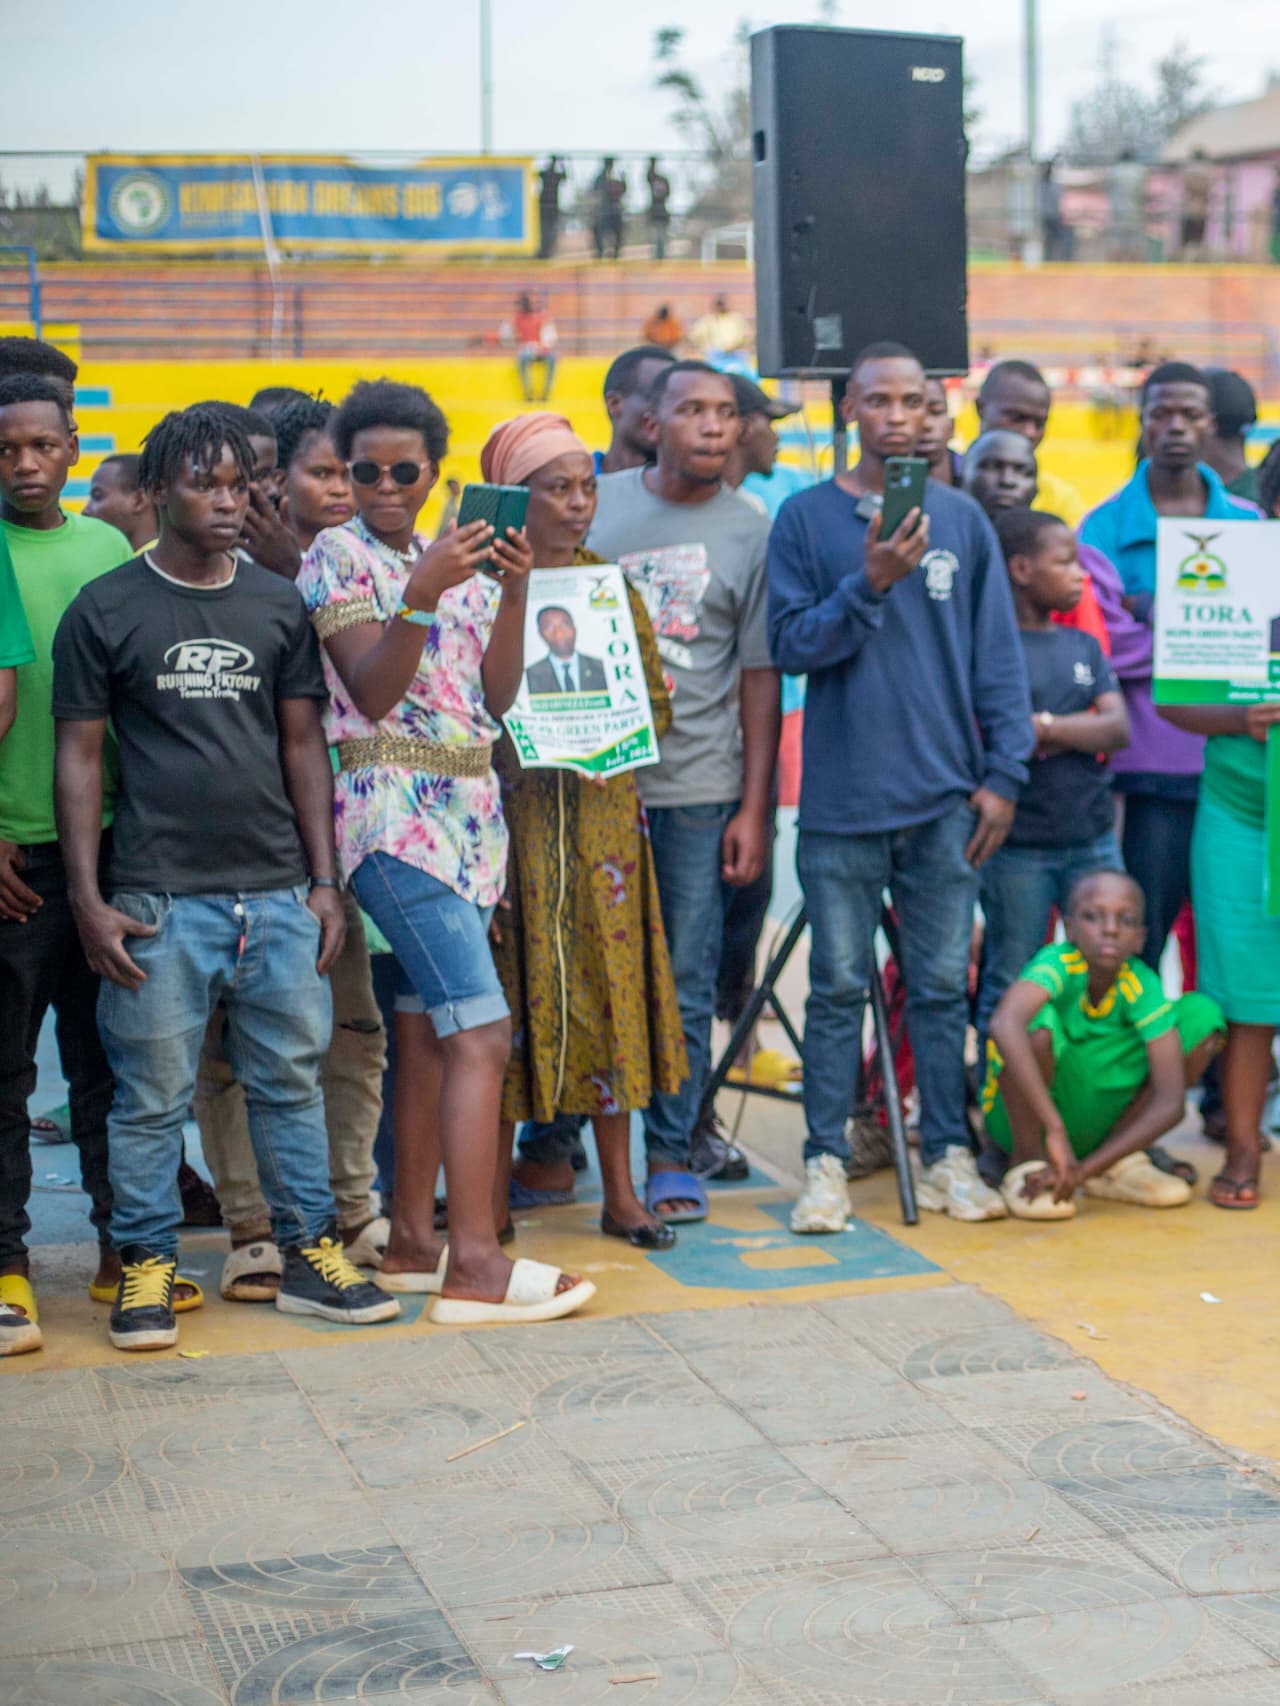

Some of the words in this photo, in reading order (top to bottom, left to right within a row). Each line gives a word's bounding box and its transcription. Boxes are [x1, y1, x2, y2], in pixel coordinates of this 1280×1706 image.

[1181, 604, 1252, 624] TORA
[175, 646, 240, 674] RF
[604, 616, 638, 705] TORA
[157, 673, 212, 690] RUNNING
